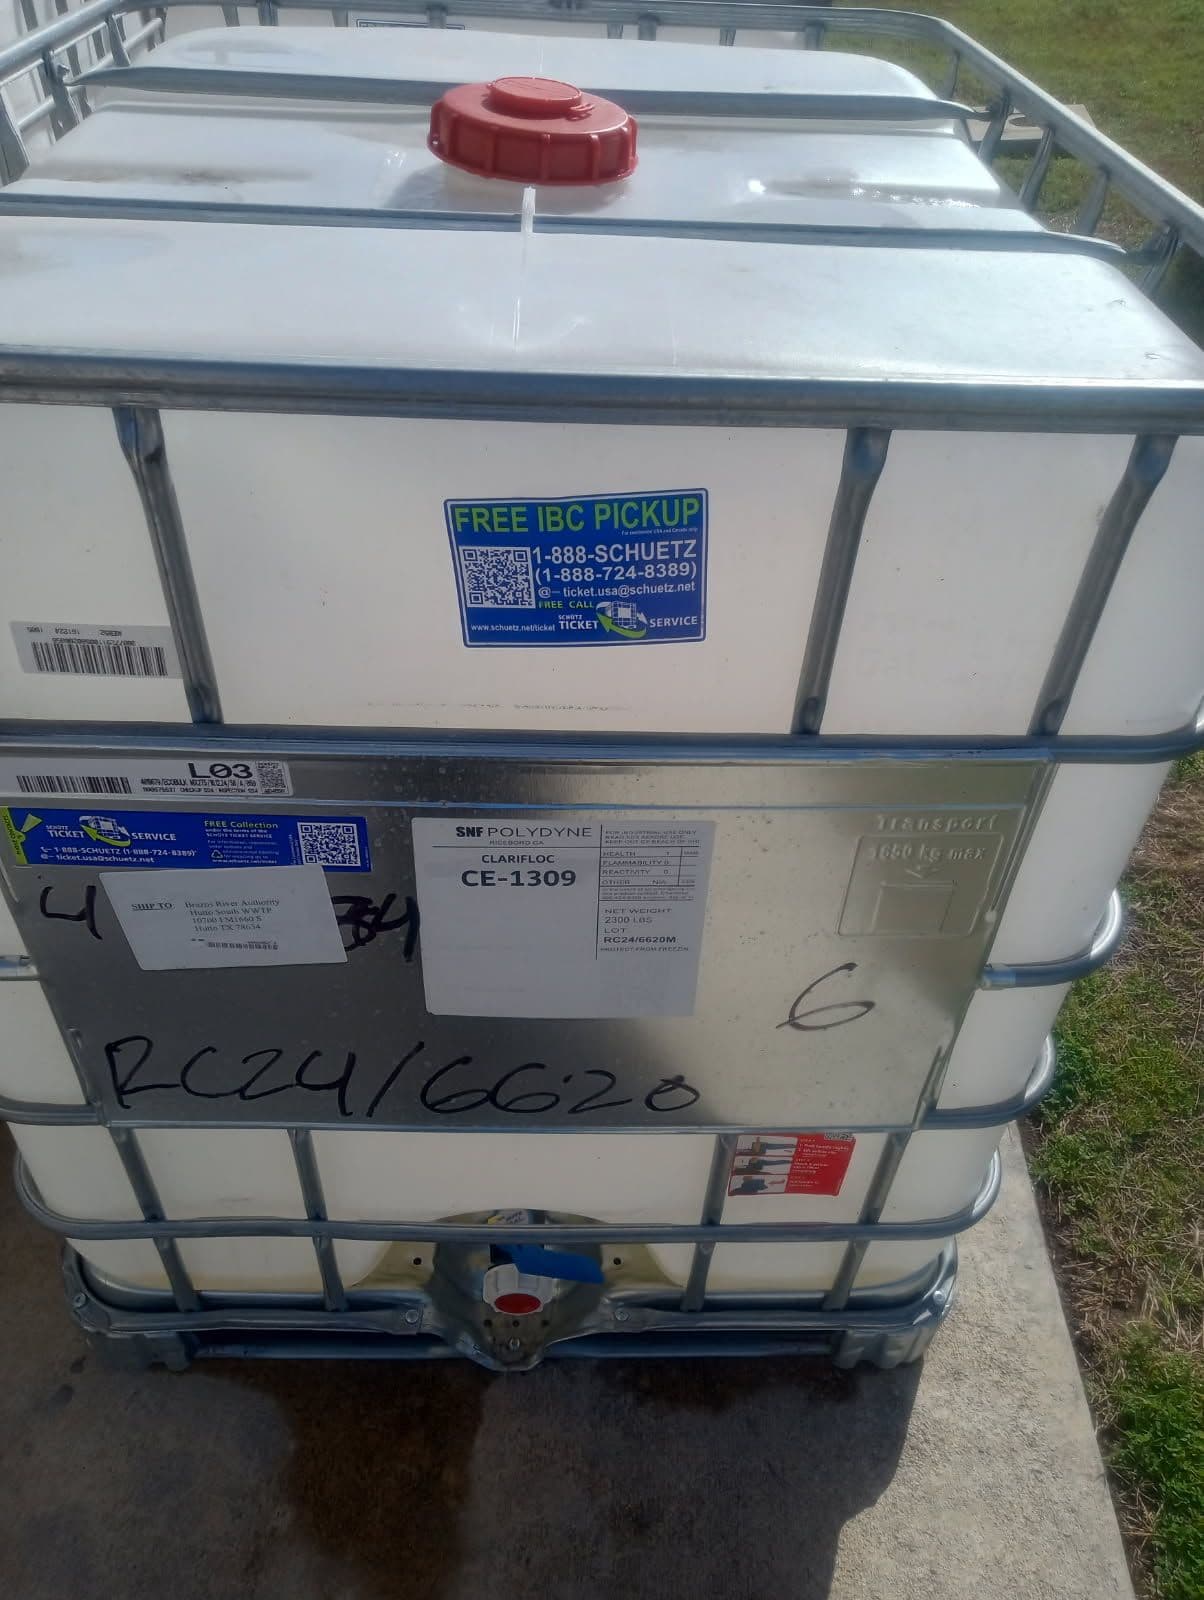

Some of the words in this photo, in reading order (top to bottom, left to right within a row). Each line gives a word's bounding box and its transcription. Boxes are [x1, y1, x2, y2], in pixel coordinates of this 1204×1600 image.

[455, 506, 529, 532] FREE
[537, 504, 585, 532] IBC
[594, 497, 700, 530] PICKUP
[532, 539, 697, 564] 1-888-SCHUETZ
[535, 562, 697, 585] (1-888-724-8389)
[563, 581, 696, 598] ticket.usa@schuetz.net
[539, 601, 563, 609] FREE
[568, 601, 594, 609] CALL
[471, 623, 556, 632] www.schuetz.net/ticket
[559, 620, 599, 630] TICKET
[649, 616, 698, 628] SERVICE
[230, 821, 279, 829] Collection
[876, 814, 999, 832] Transport
[49, 830, 85, 838] TICKET
[131, 832, 177, 841] SERVICE
[456, 826, 484, 838] SNF
[488, 827, 592, 838] POLYDYNE
[919, 843, 943, 862] kg
[949, 848, 987, 861] max
[481, 854, 555, 864] CLARIFLOC
[461, 870, 577, 887] CE-1309
[131, 902, 156, 911] SHIP
[158, 902, 173, 910] TO
[216, 900, 240, 908] River
[604, 916, 630, 924] 2300
[633, 916, 654, 924] LBS
[603, 936, 677, 944] RC24/6620M
[107, 1034, 702, 1118] RC24/6620
